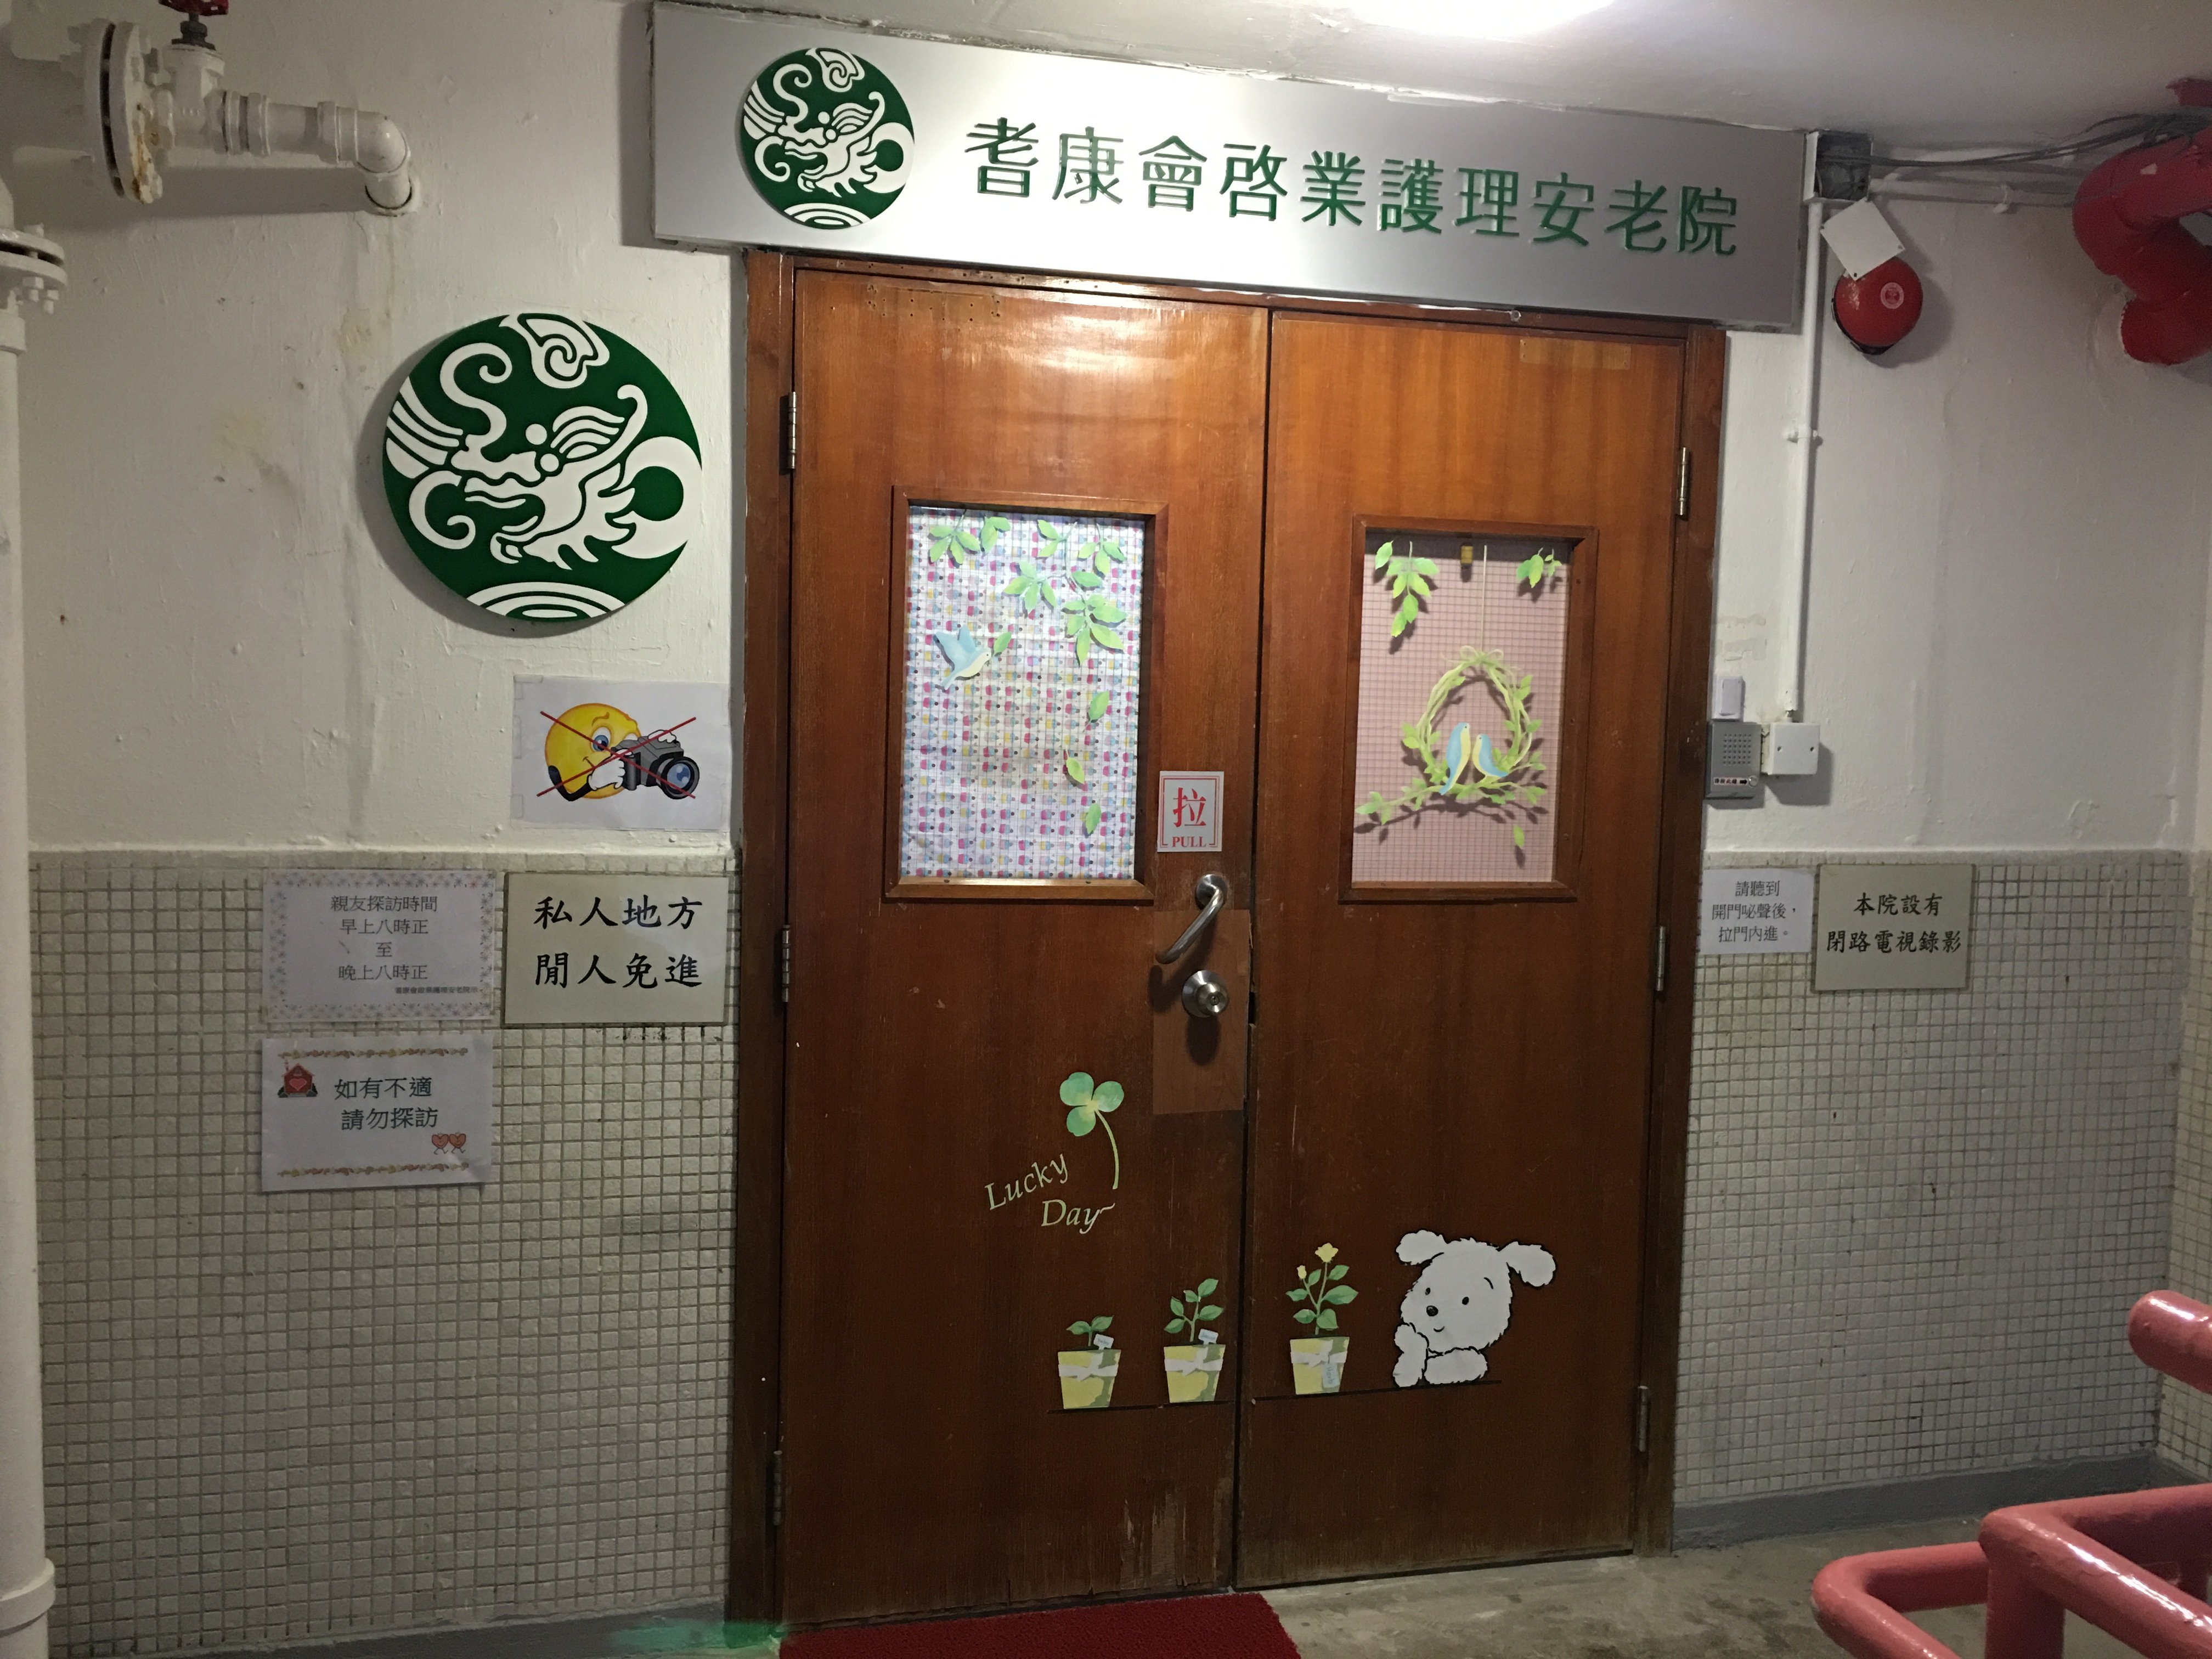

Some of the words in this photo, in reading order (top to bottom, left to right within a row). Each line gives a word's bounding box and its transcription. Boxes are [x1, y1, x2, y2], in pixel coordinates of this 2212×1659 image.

[1172, 787, 1207, 828] 拉
[1171, 836, 1207, 848] PULL
[1735, 880, 1781, 897] 請聽到
[331, 895, 438, 912] 親友探訪時間
[533, 894, 703, 930] 私人地方
[1853, 892, 1943, 917] 本院設有
[340, 918, 429, 935] 早上八時正
[375, 941, 393, 958] 至
[1826, 929, 1962, 953] 閉路電視錄影
[337, 964, 428, 981] 晚上八時正
[334, 1076, 432, 1100] 如有不適
[341, 1107, 439, 1130] 請勿探訪
[984, 1153, 1068, 1210] Lucky
[1041, 1199, 1115, 1234] Day
